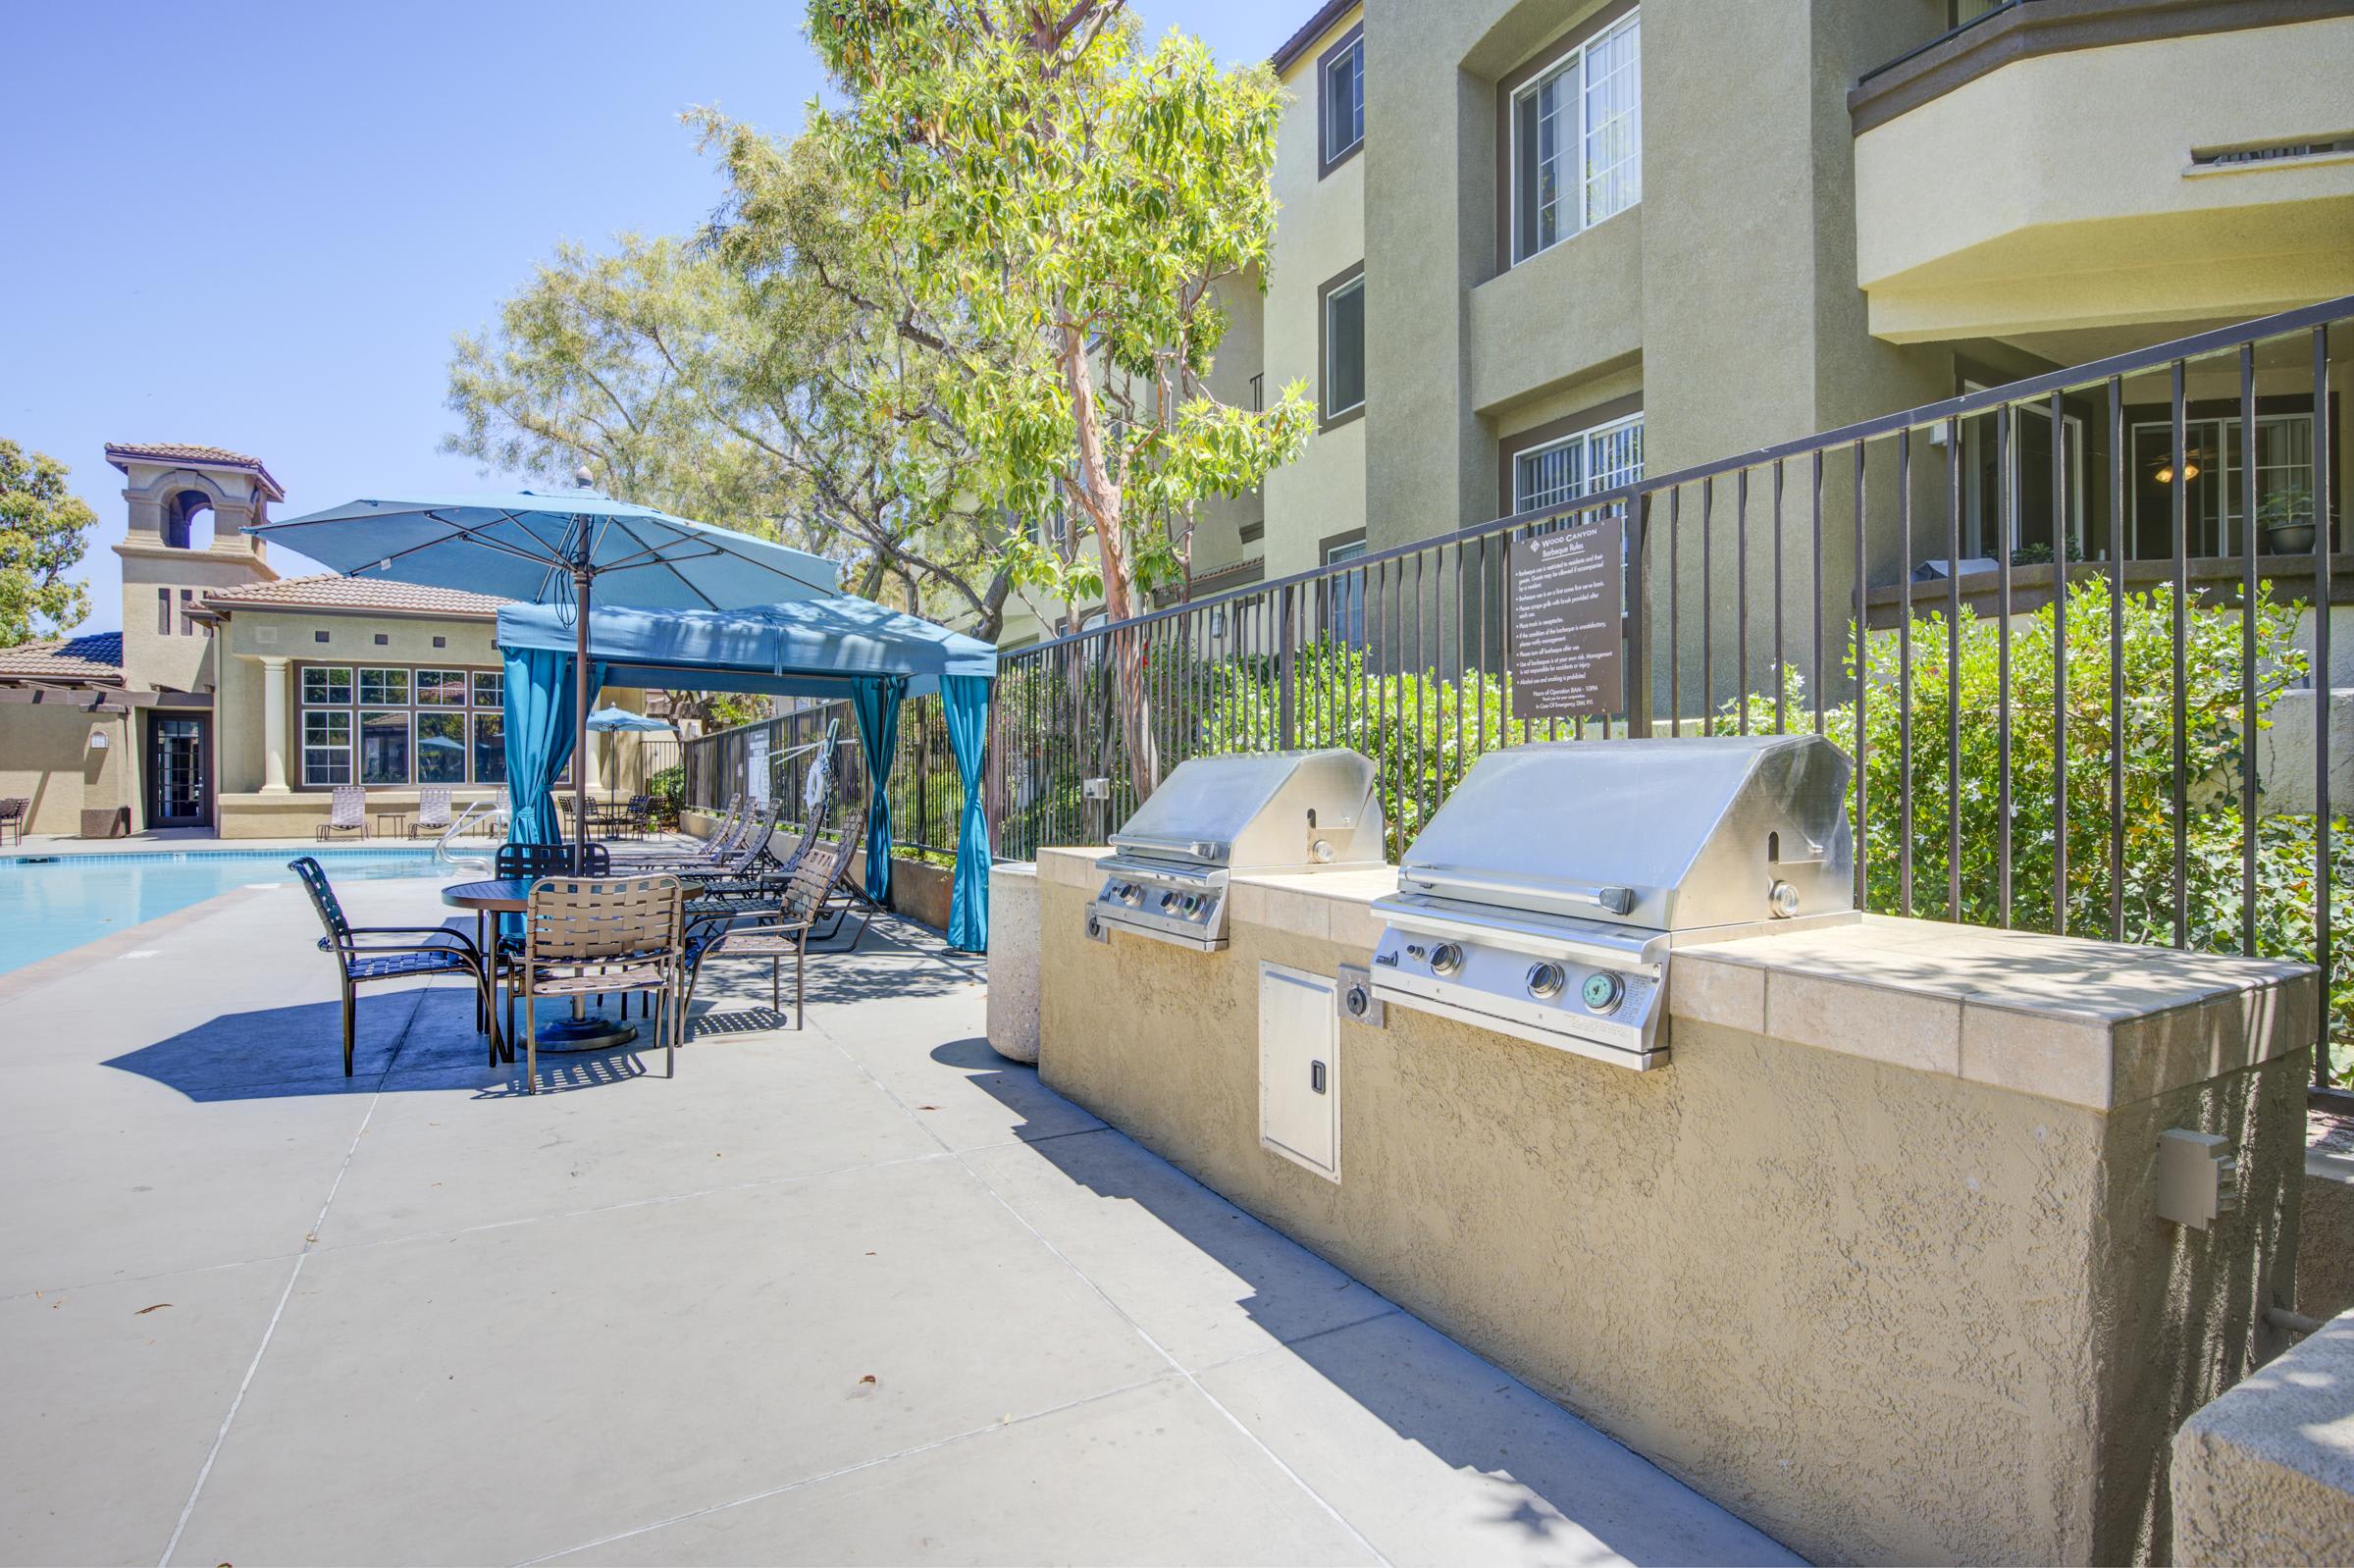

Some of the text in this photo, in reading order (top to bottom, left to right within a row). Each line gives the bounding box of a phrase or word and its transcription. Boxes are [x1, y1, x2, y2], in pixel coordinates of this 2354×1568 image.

[1542, 528, 1597, 547] WOOD CANYON
[1542, 542, 1583, 558] Barbeque Rules
[1571, 593, 1588, 603] provided
[1586, 651, 1612, 660] Management
